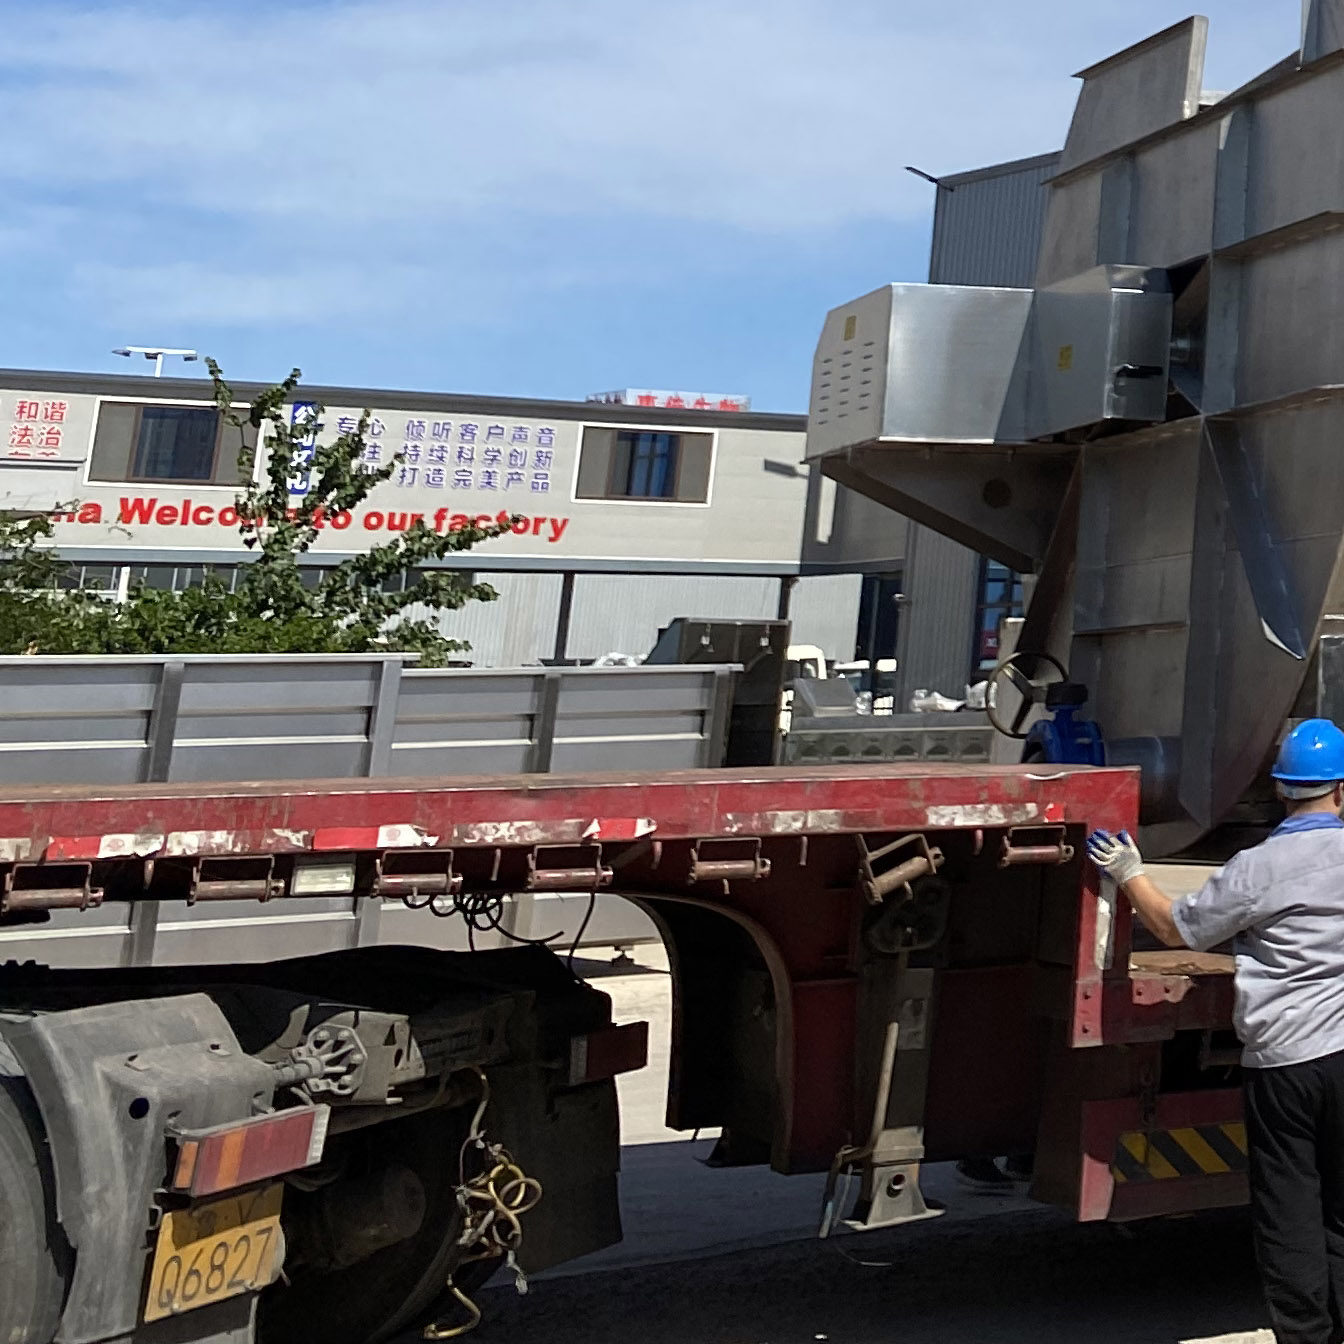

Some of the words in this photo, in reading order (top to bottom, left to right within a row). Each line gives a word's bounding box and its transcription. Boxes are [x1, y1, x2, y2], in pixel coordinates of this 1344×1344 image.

[16, 400, 67, 421] 和谐
[10, 425, 61, 446] 法治
[336, 417, 386, 436] 专心
[406, 420, 555, 446] 倾听客户声音
[402, 444, 553, 469] 持续科学创新
[399, 467, 550, 491] 打造完美产品
[120, 498, 298, 527] Welco
[311, 503, 352, 529] to
[363, 511, 424, 531] our
[158, 1226, 273, 1308] Q6827
